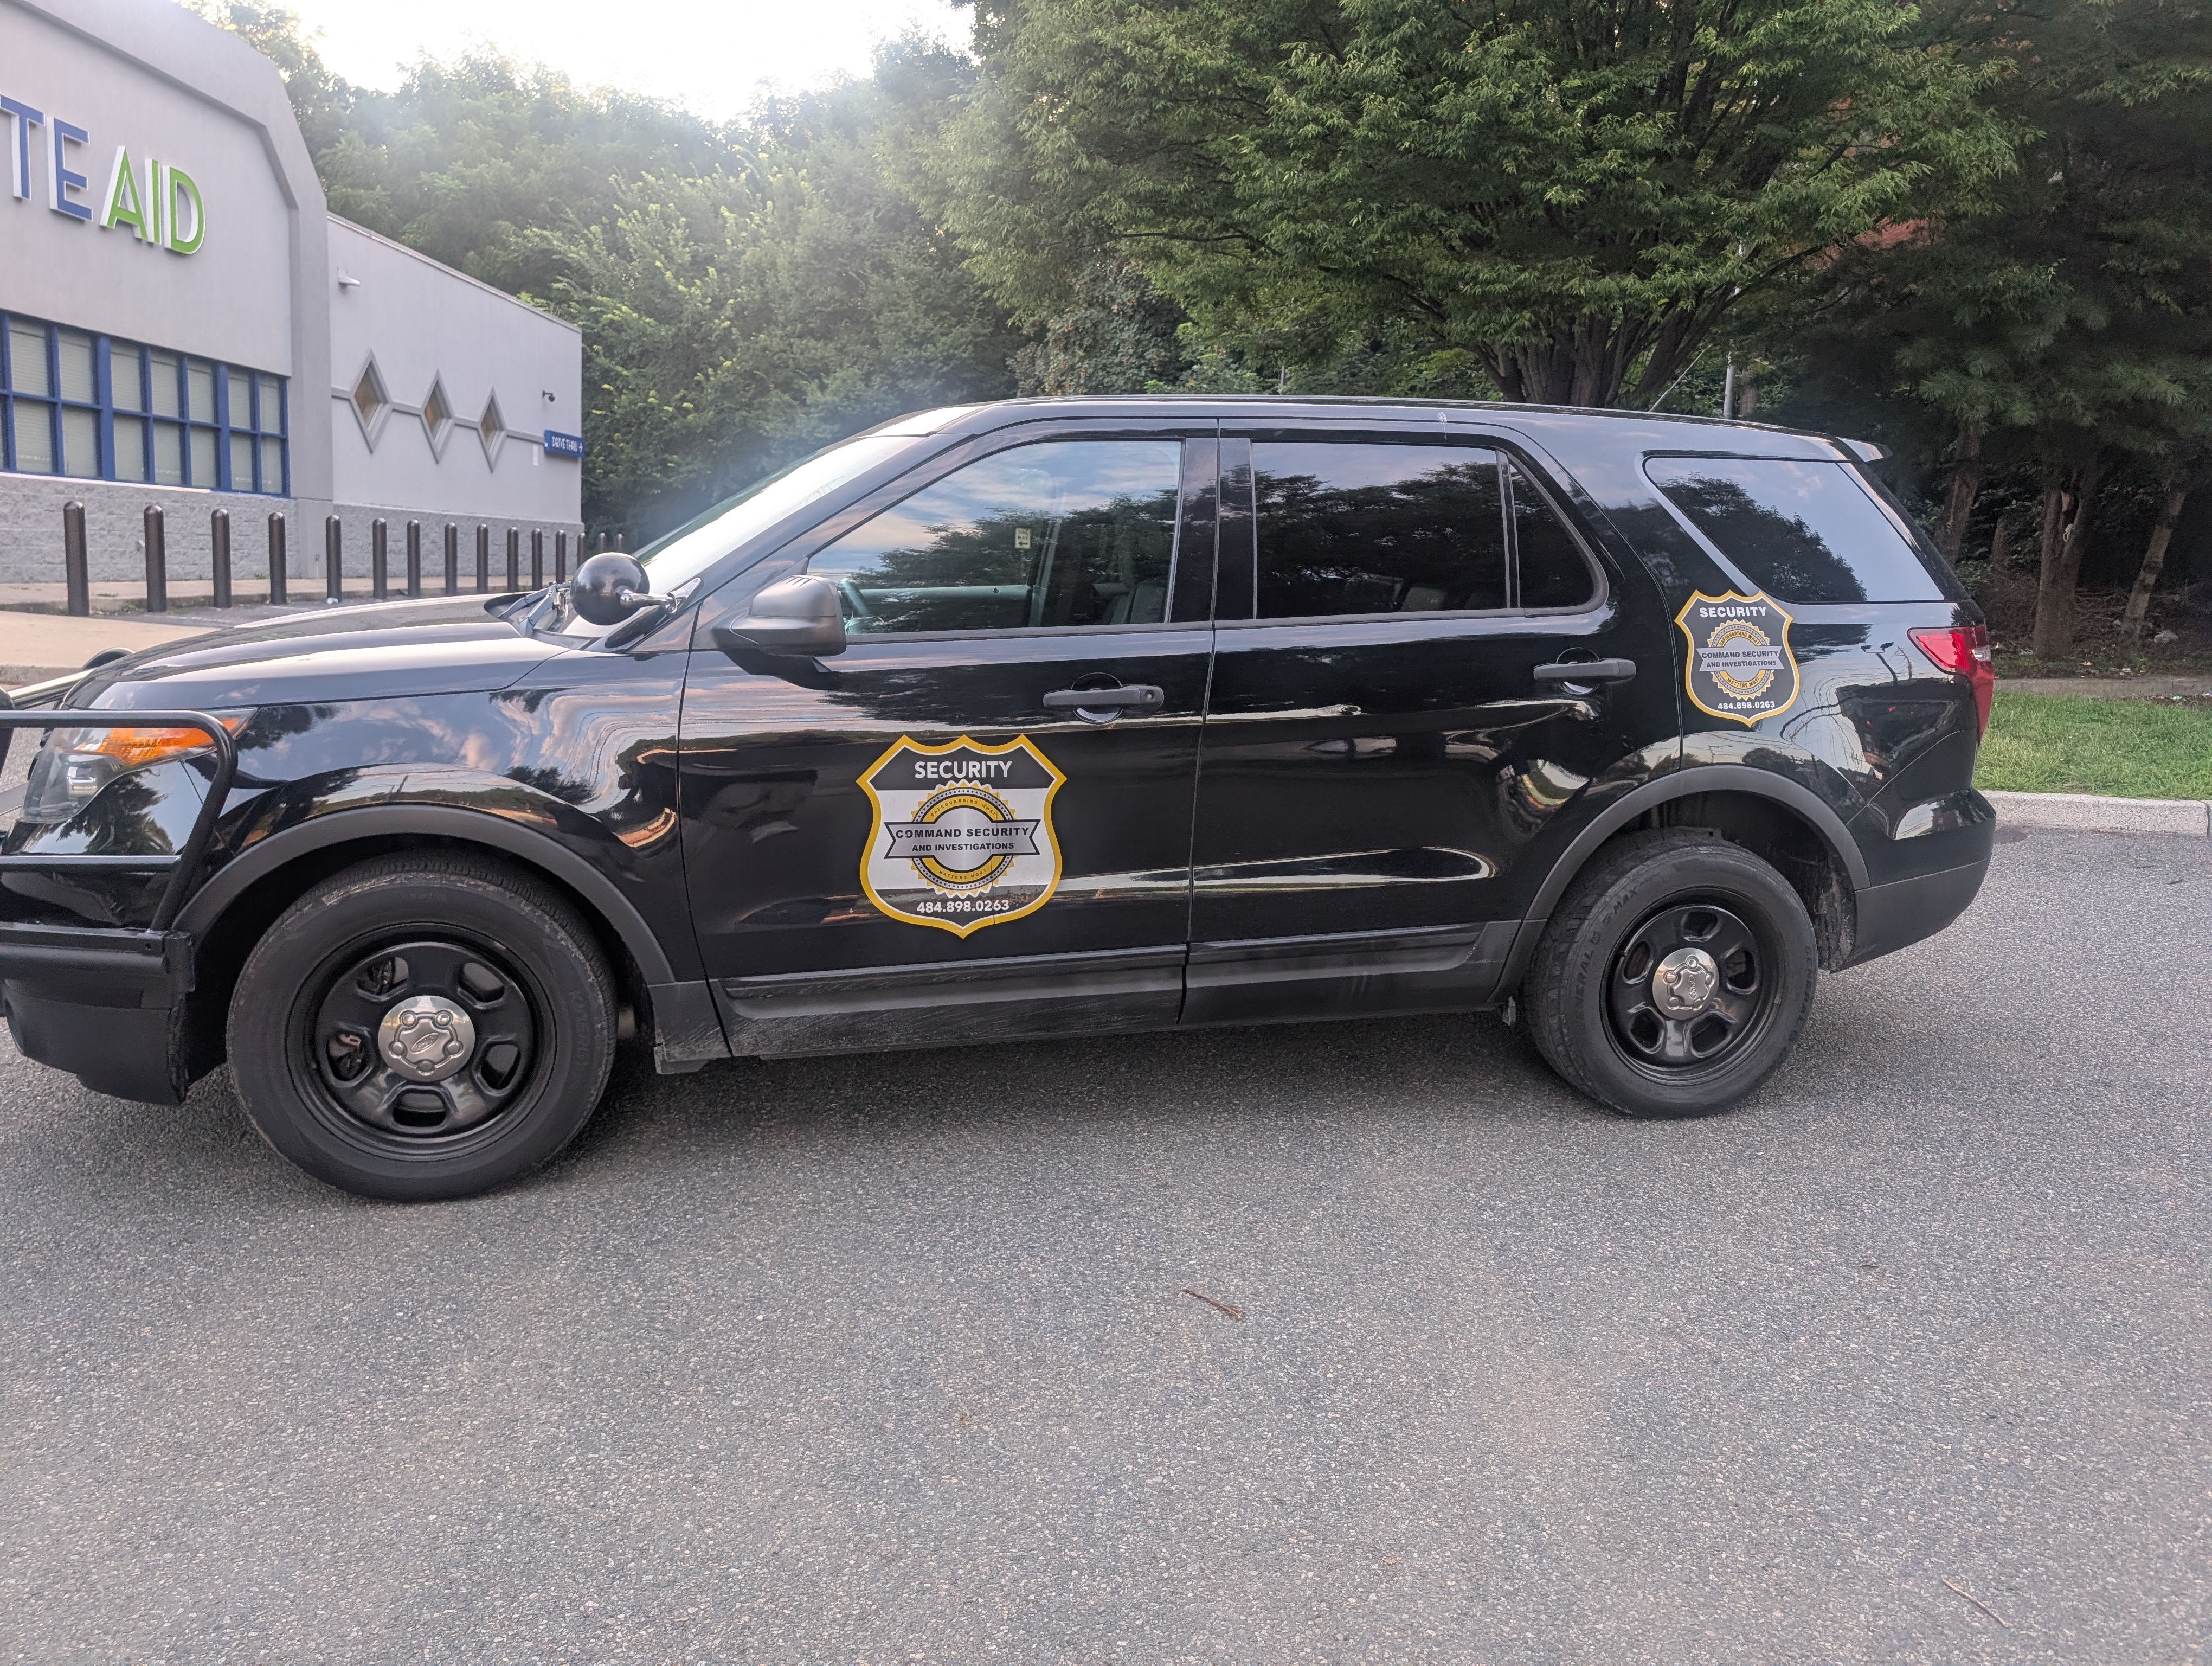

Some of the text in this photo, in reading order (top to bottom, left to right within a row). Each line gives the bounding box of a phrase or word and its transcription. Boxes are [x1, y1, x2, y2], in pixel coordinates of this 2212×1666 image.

[0, 94, 205, 255] TE AID
[551, 435, 578, 452] DRIVE THRU
[1699, 606, 1767, 618] SECURITY
[1719, 631, 1760, 646] SAFEGUARDING WHAT
[1701, 651, 1740, 659] COMMAND
[1727, 676, 1760, 688] MATTERS MOST
[1718, 701, 1776, 710] 484.898.0263
[914, 760, 1013, 779] SECURITY
[930, 799, 997, 817] SAFEGUARDING WHAT
[895, 826, 1030, 838] COMMAND SECURITY
[935, 842, 1014, 851] INVESTIGATIONS
[938, 869, 986, 880] MATTERS MOST
[916, 900, 1009, 913] 484.898.0263
